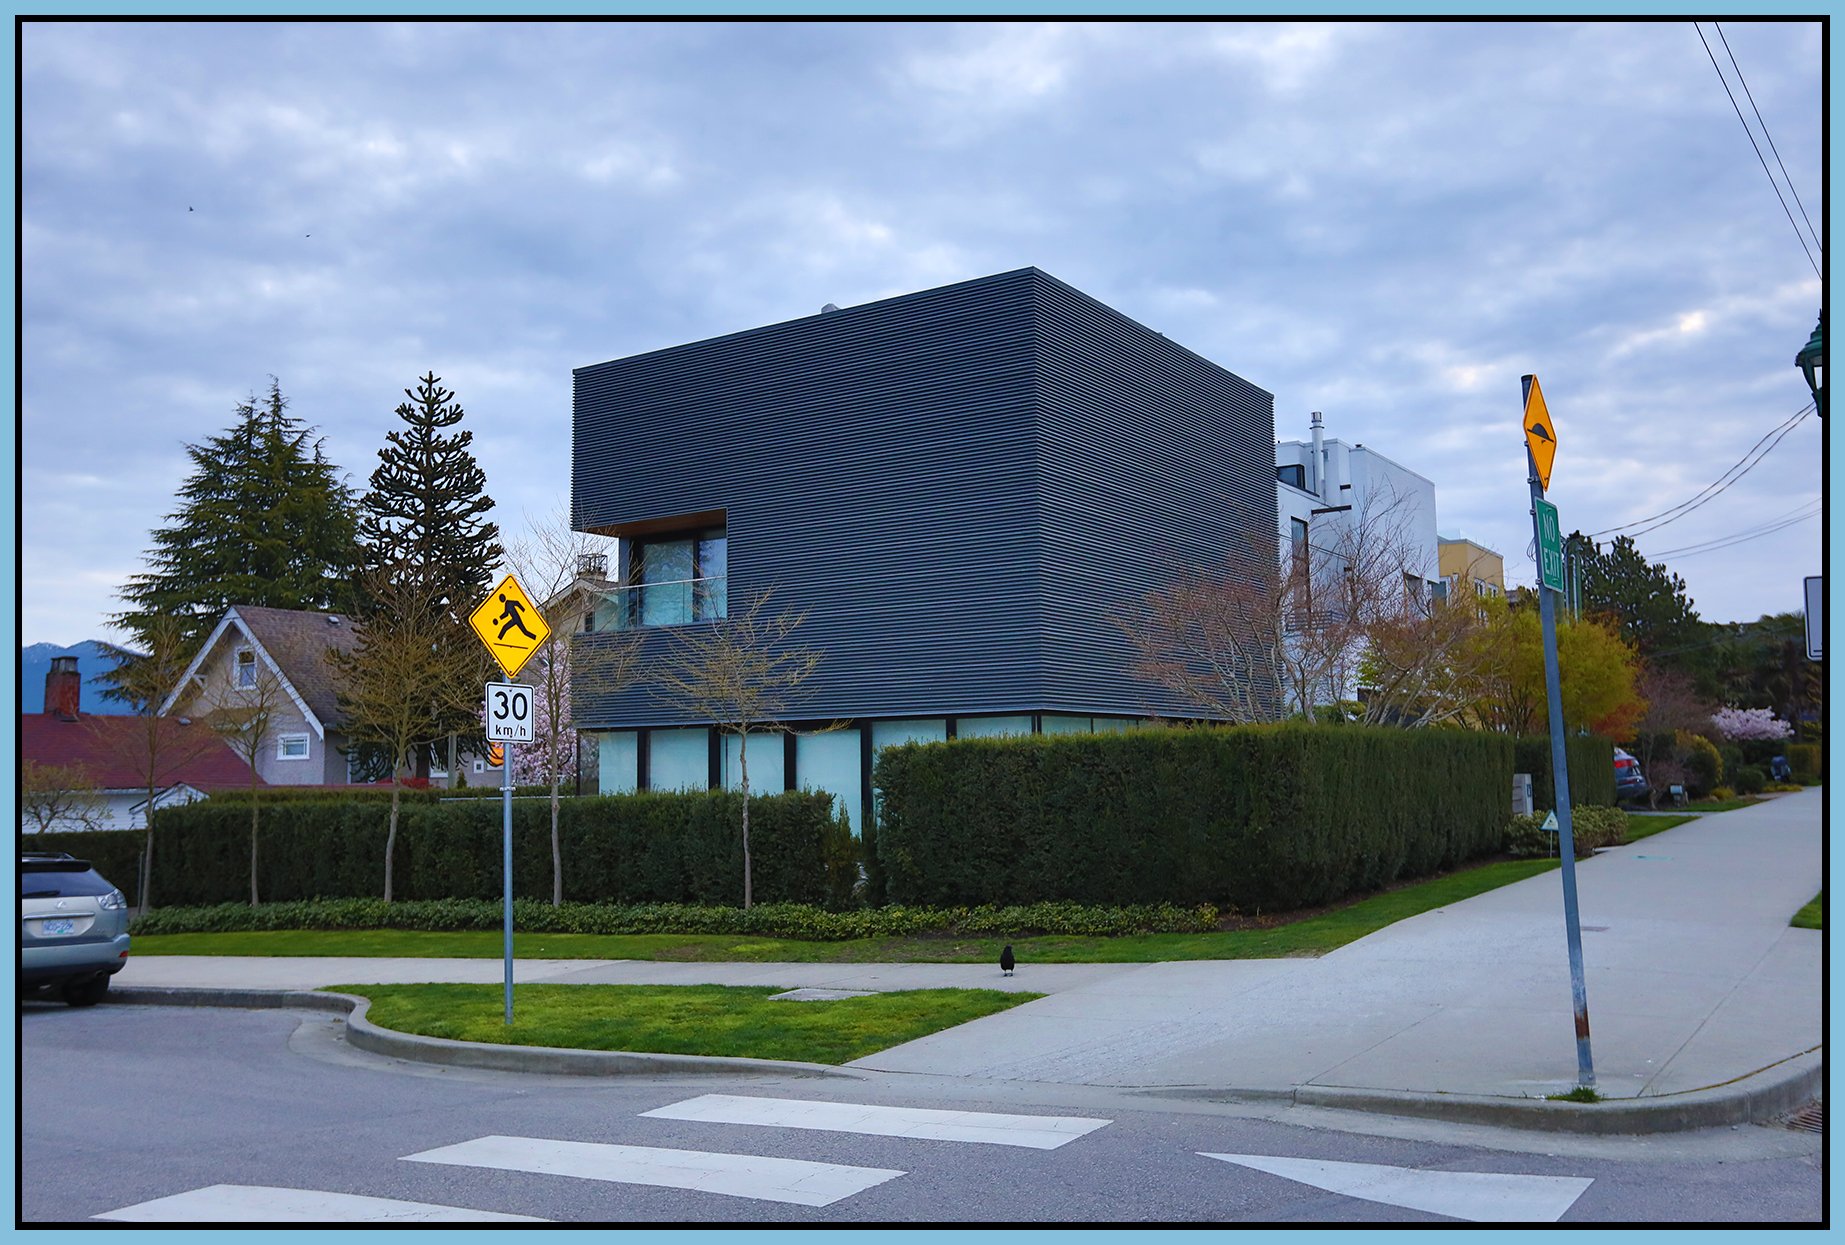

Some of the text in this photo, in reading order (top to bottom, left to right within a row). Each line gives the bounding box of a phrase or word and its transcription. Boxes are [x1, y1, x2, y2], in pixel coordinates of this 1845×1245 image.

[1542, 512, 1556, 543] NO
[1543, 548, 1560, 579] EXIT
[493, 691, 528, 721] 30
[495, 724, 526, 737] km/h
